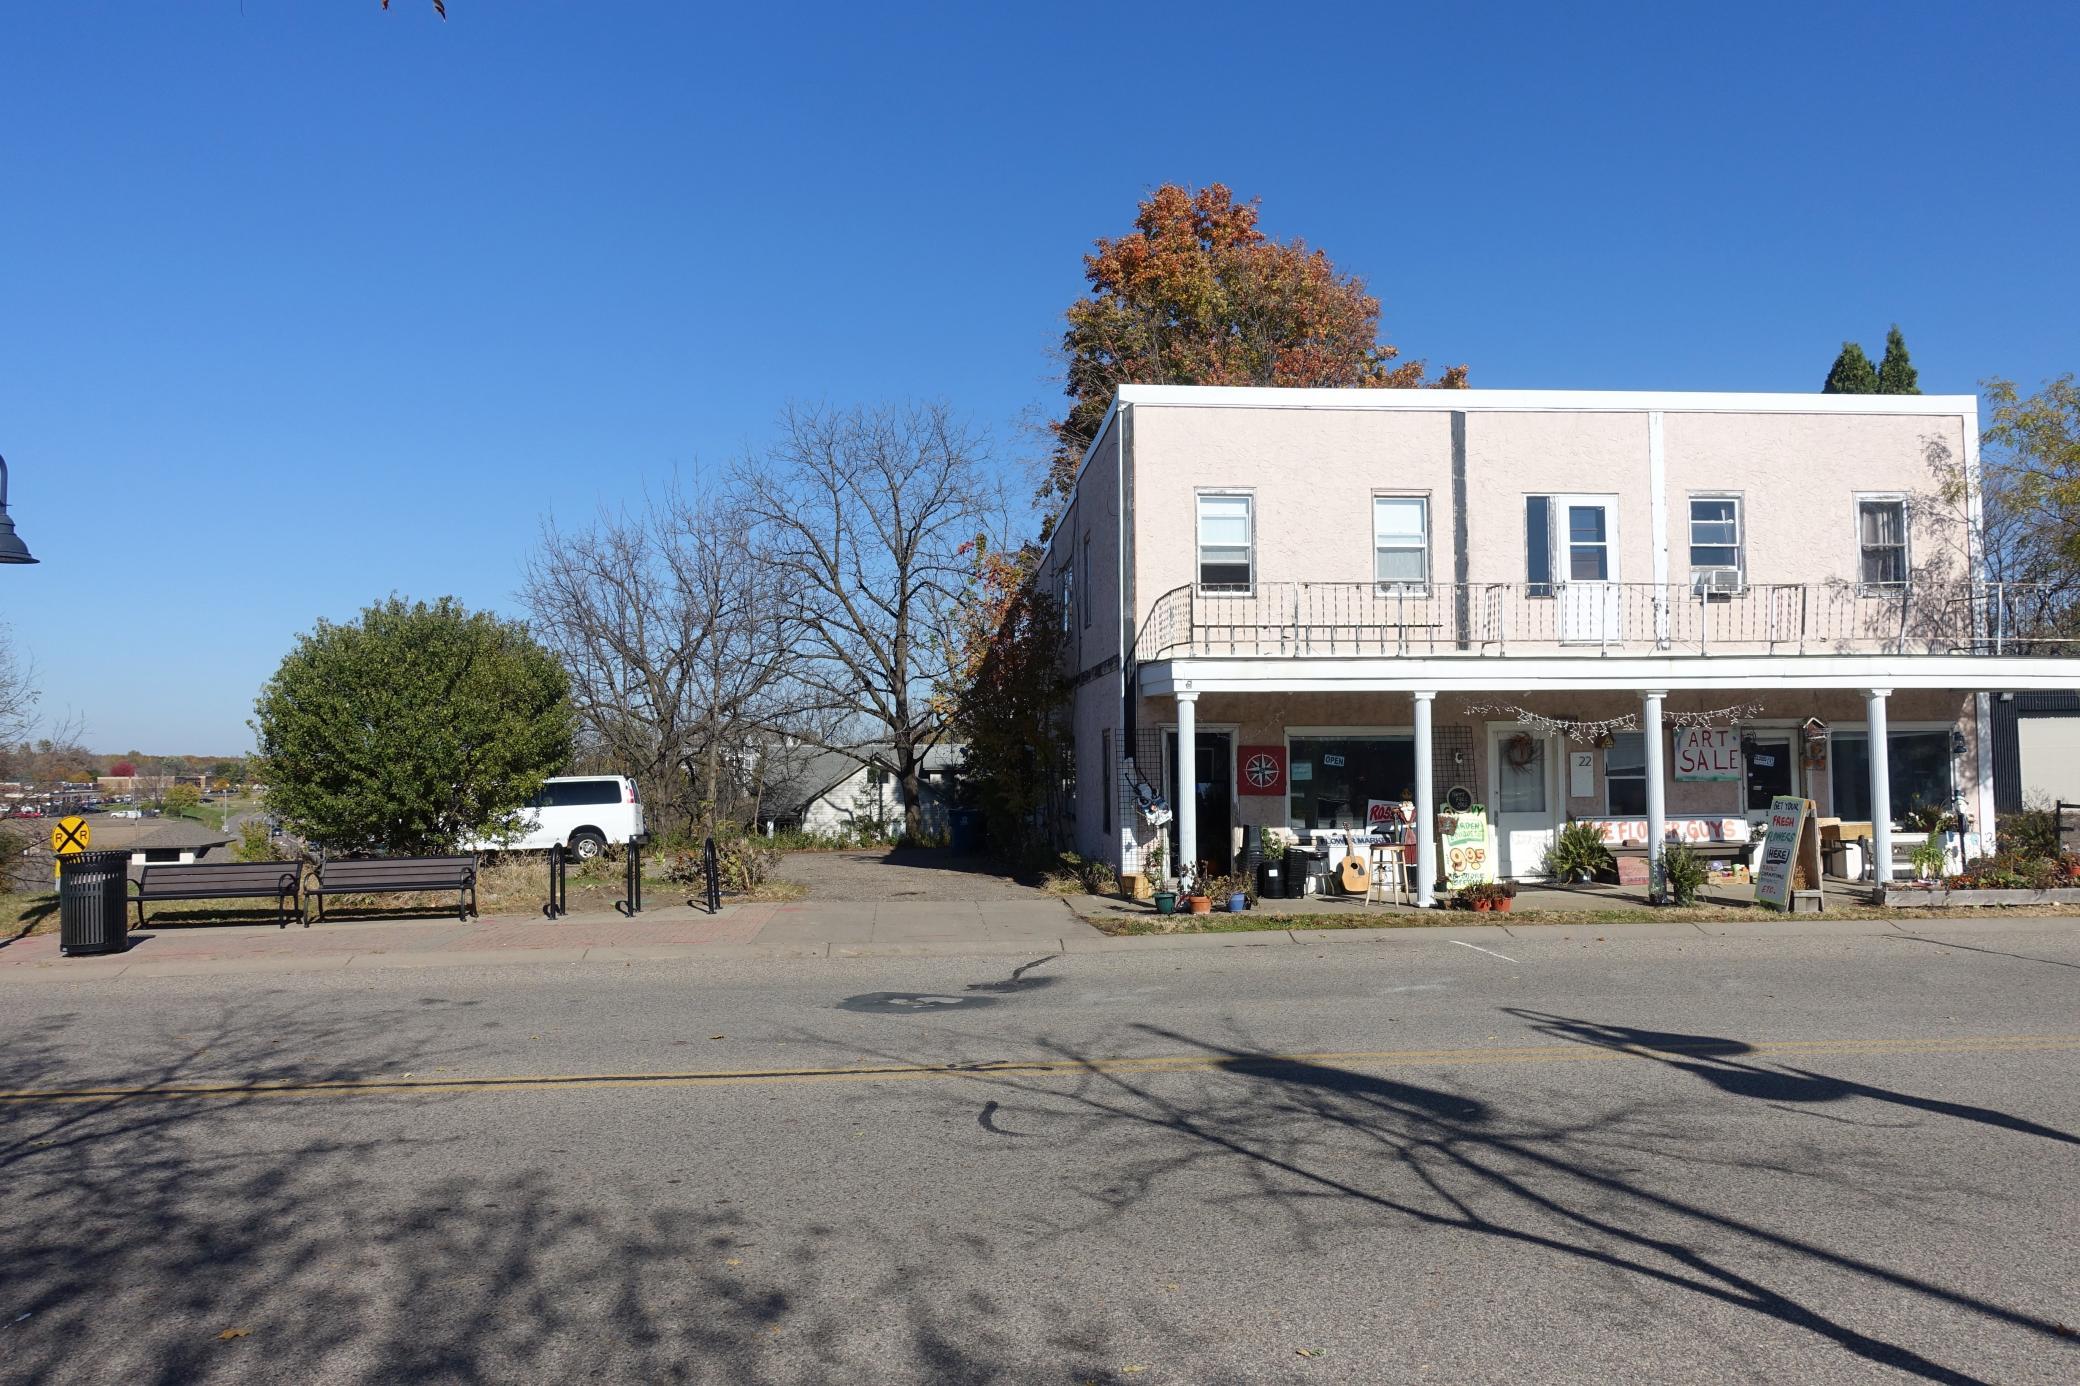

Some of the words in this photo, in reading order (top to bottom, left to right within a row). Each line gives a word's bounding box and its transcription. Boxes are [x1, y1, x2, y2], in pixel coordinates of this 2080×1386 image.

[1689, 730, 1729, 748] ART
[1325, 755, 1344, 766] OPEN
[1579, 756, 1592, 766] 22
[1680, 750, 1739, 773] SALE
[1774, 801, 1784, 811] GET
[1785, 802, 1799, 811] YOUR
[1773, 815, 1795, 828] FRESH
[56, 833, 63, 843] R
[80, 830, 88, 840] R
[1618, 821, 1681, 841] FLOER
[1687, 820, 1736, 840] GUYS
[1320, 837, 1356, 846] FLOWR
[1769, 849, 1787, 860] HERE
